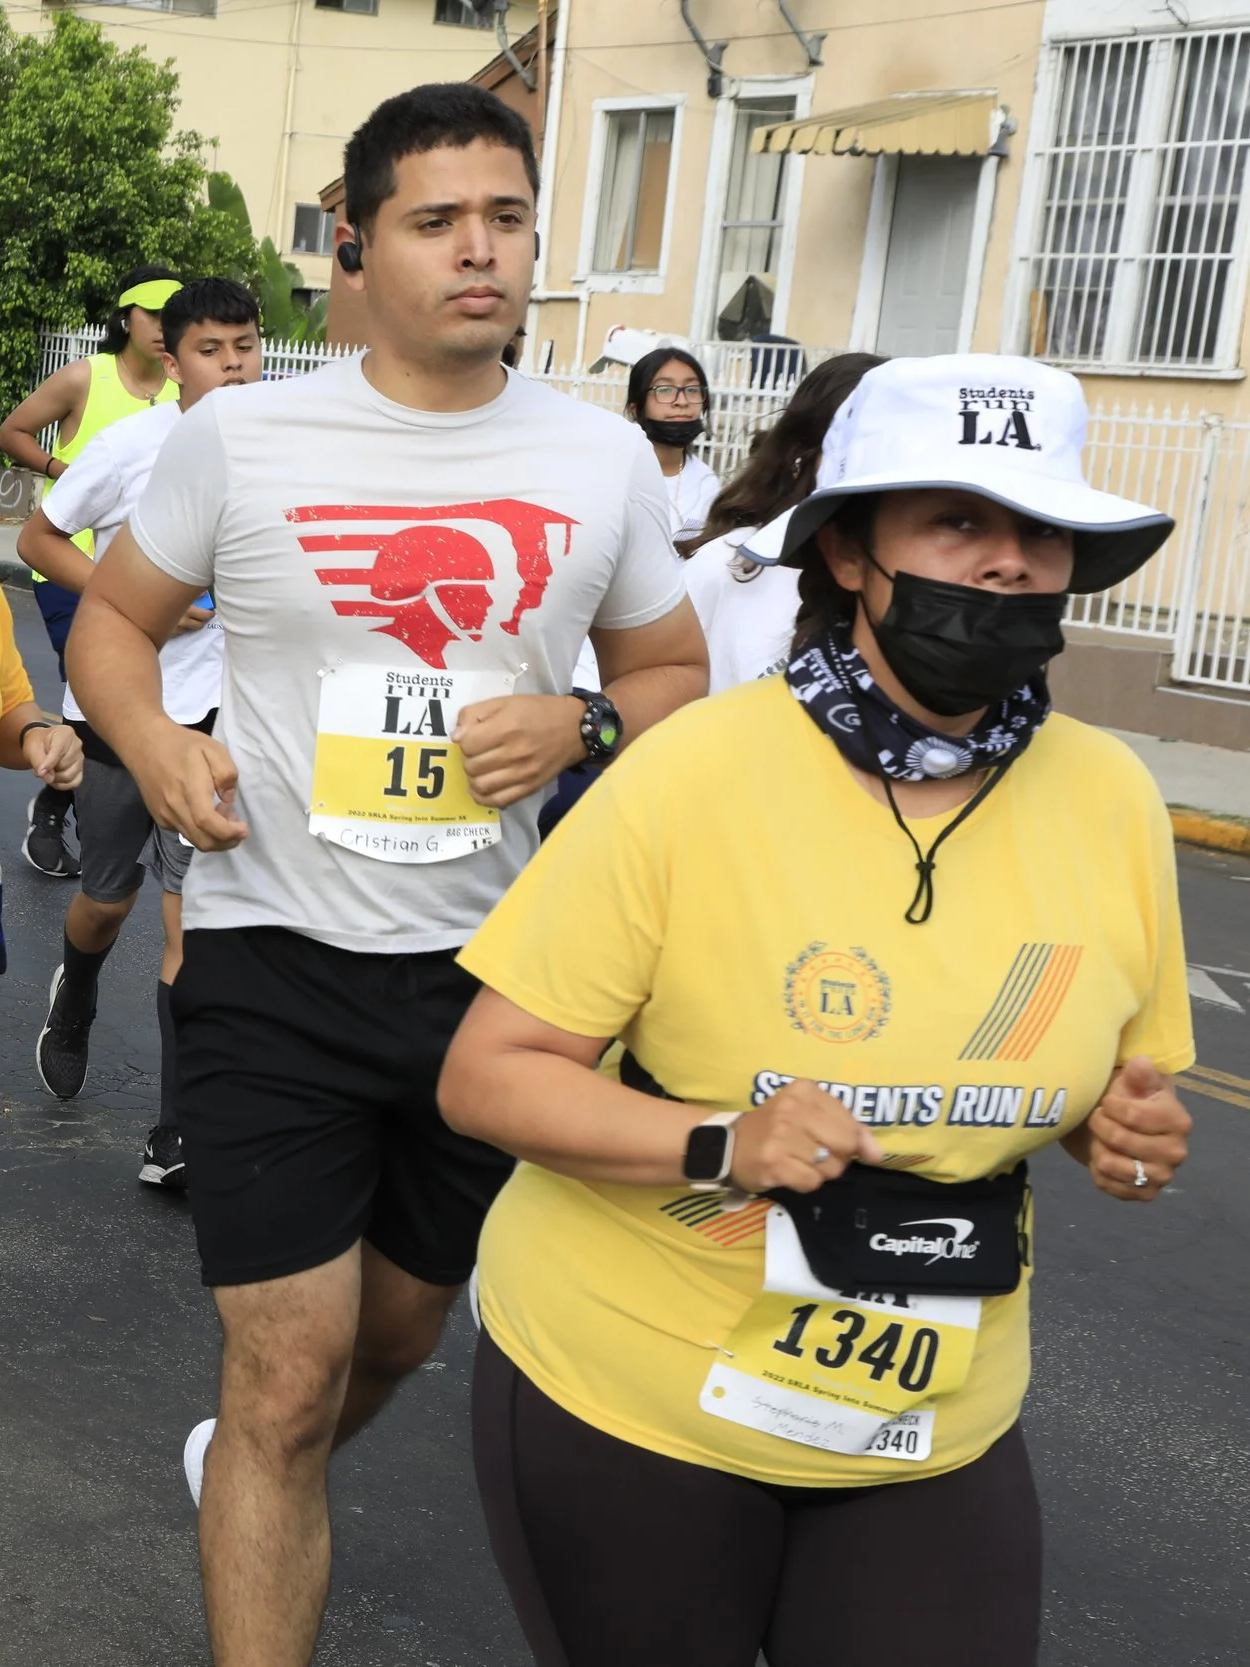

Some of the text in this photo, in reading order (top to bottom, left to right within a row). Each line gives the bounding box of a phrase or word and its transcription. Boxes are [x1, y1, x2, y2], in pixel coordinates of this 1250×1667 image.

[958, 387, 1035, 400] Students
[960, 399, 1034, 412] run
[958, 410, 1036, 450] LA
[386, 671, 453, 687] Students
[387, 685, 451, 698] run
[381, 696, 448, 737] LA
[383, 746, 448, 799] 15
[389, 814, 413, 822] Spring
[446, 827, 490, 837] BAG CHECK
[820, 992, 854, 1016] LA
[752, 1070, 1068, 1128] SDENTS RUN LA
[772, 1303, 940, 1392] 1340
[762, 1370, 785, 1383] 2022
[788, 1378, 810, 1391] SRLA
[813, 1386, 841, 1400] Spring
[862, 1400, 899, 1416] Summer
[890, 1414, 922, 1426] HECK
